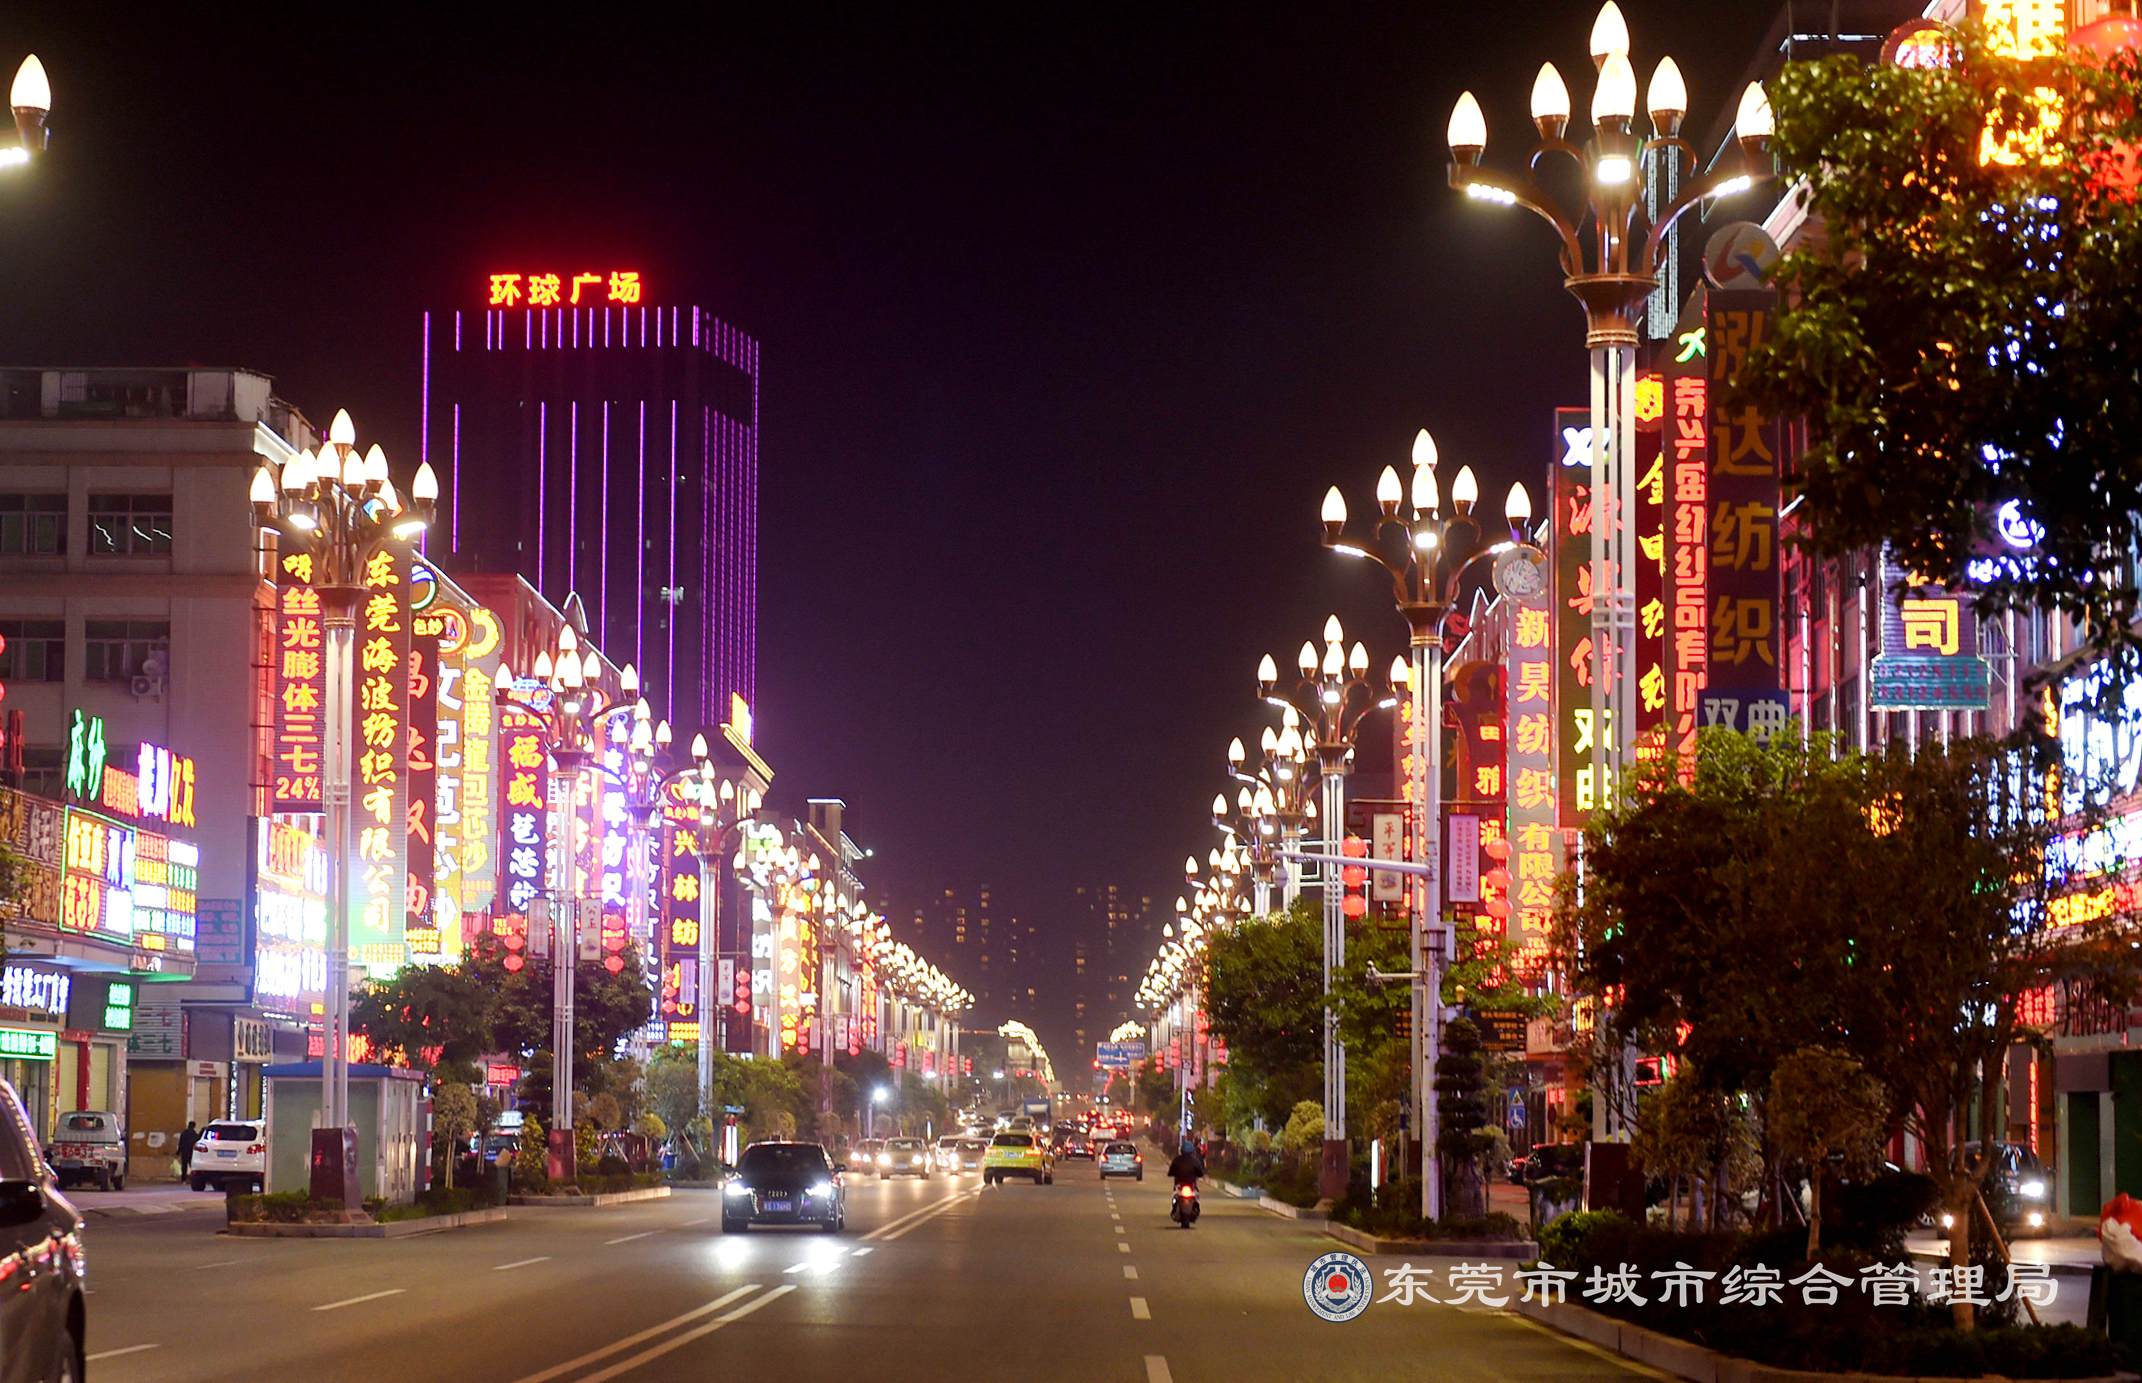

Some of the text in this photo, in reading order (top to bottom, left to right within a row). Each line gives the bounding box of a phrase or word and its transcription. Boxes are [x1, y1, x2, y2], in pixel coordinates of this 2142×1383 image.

[489, 271, 641, 306] 环球广场
[279, 586, 321, 773] 丝光膨体三七
[359, 550, 402, 933] 东莞海波纺织有限公司
[1515, 606, 1554, 933] 新昊纺织有限公司
